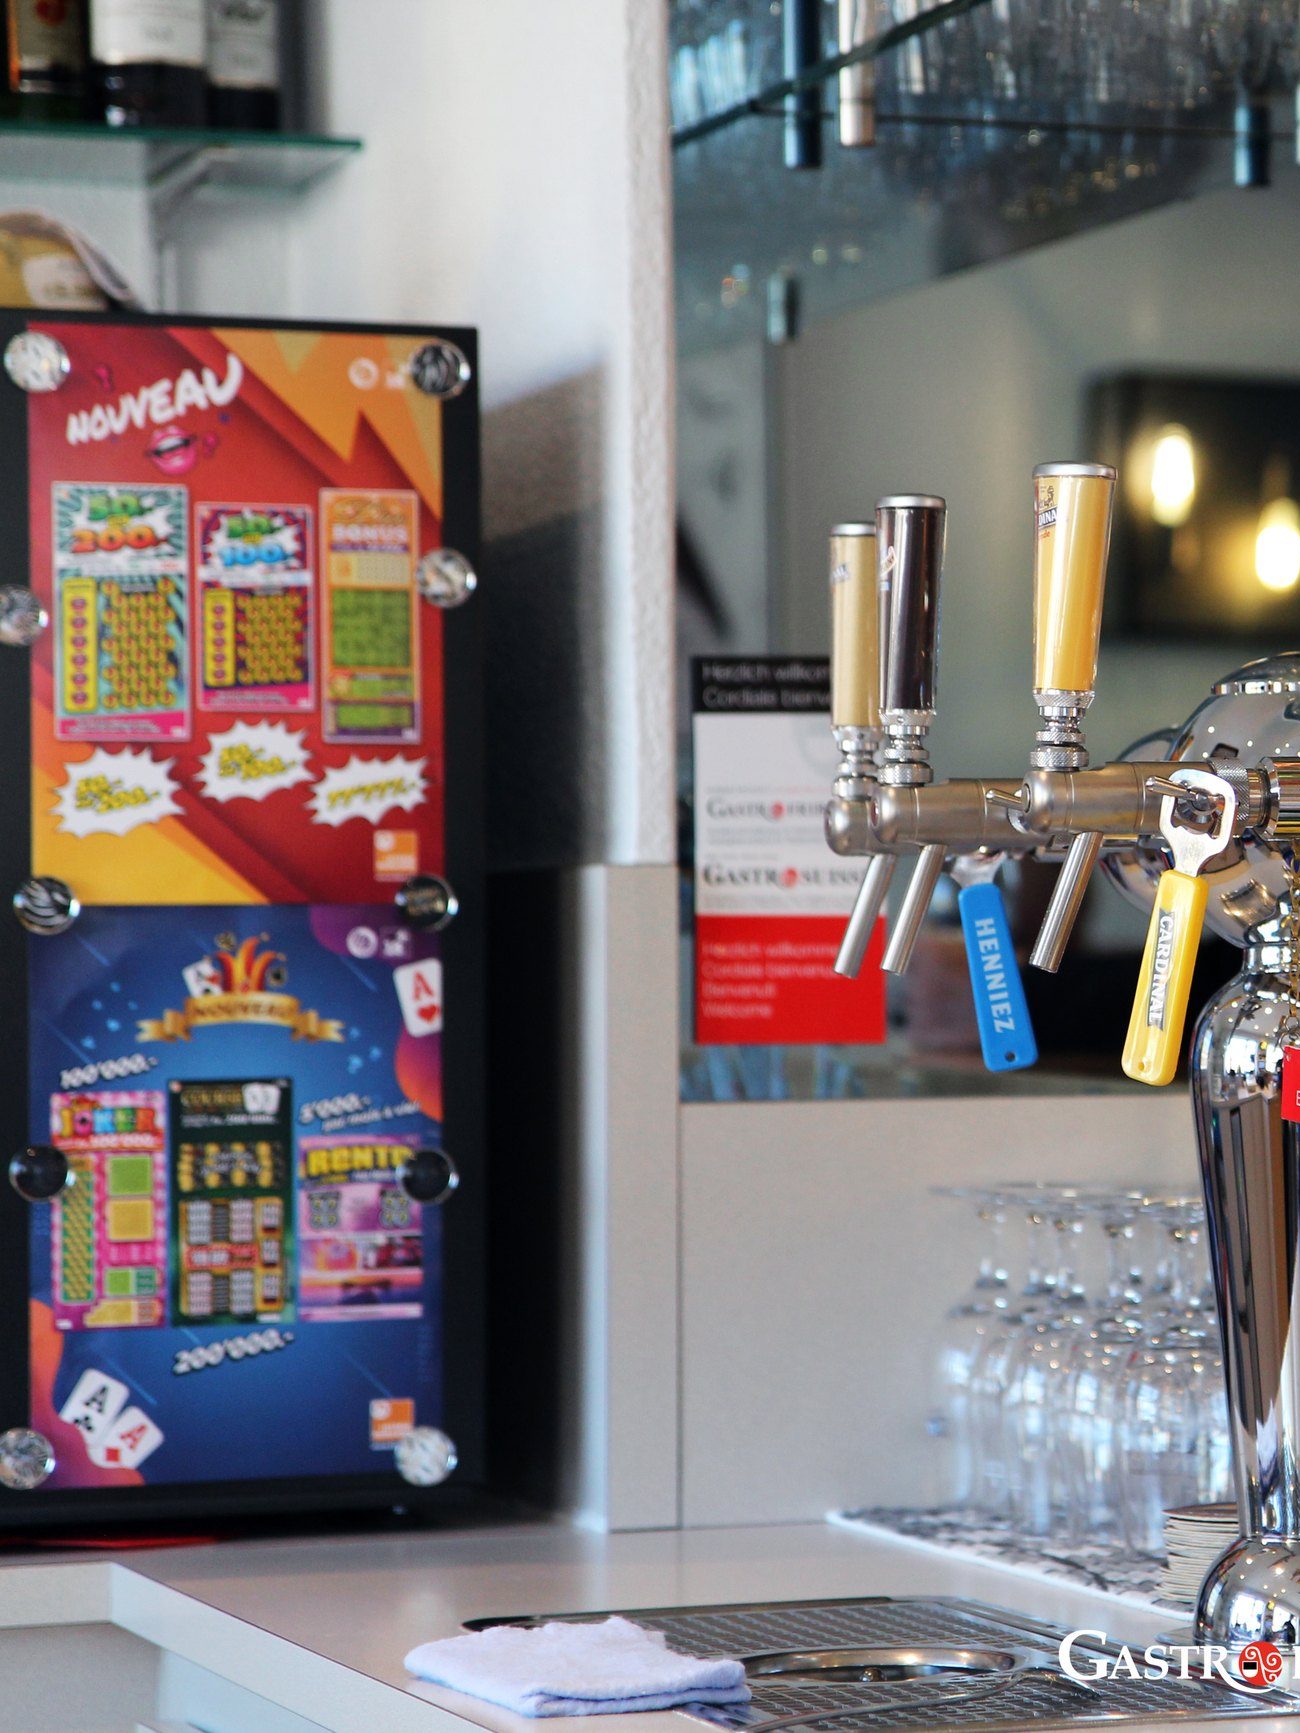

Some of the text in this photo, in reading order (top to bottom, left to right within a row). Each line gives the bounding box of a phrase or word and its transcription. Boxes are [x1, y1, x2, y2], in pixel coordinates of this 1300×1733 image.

[66, 354, 243, 446] NOUVEAU
[414, 970, 435, 1001] A
[975, 917, 1015, 1034] HENNIEZ
[1148, 915, 1174, 1025] CARDINAL
[61, 1107, 155, 1138] JOKER
[84, 1385, 109, 1414] A
[119, 1423, 147, 1450] A
